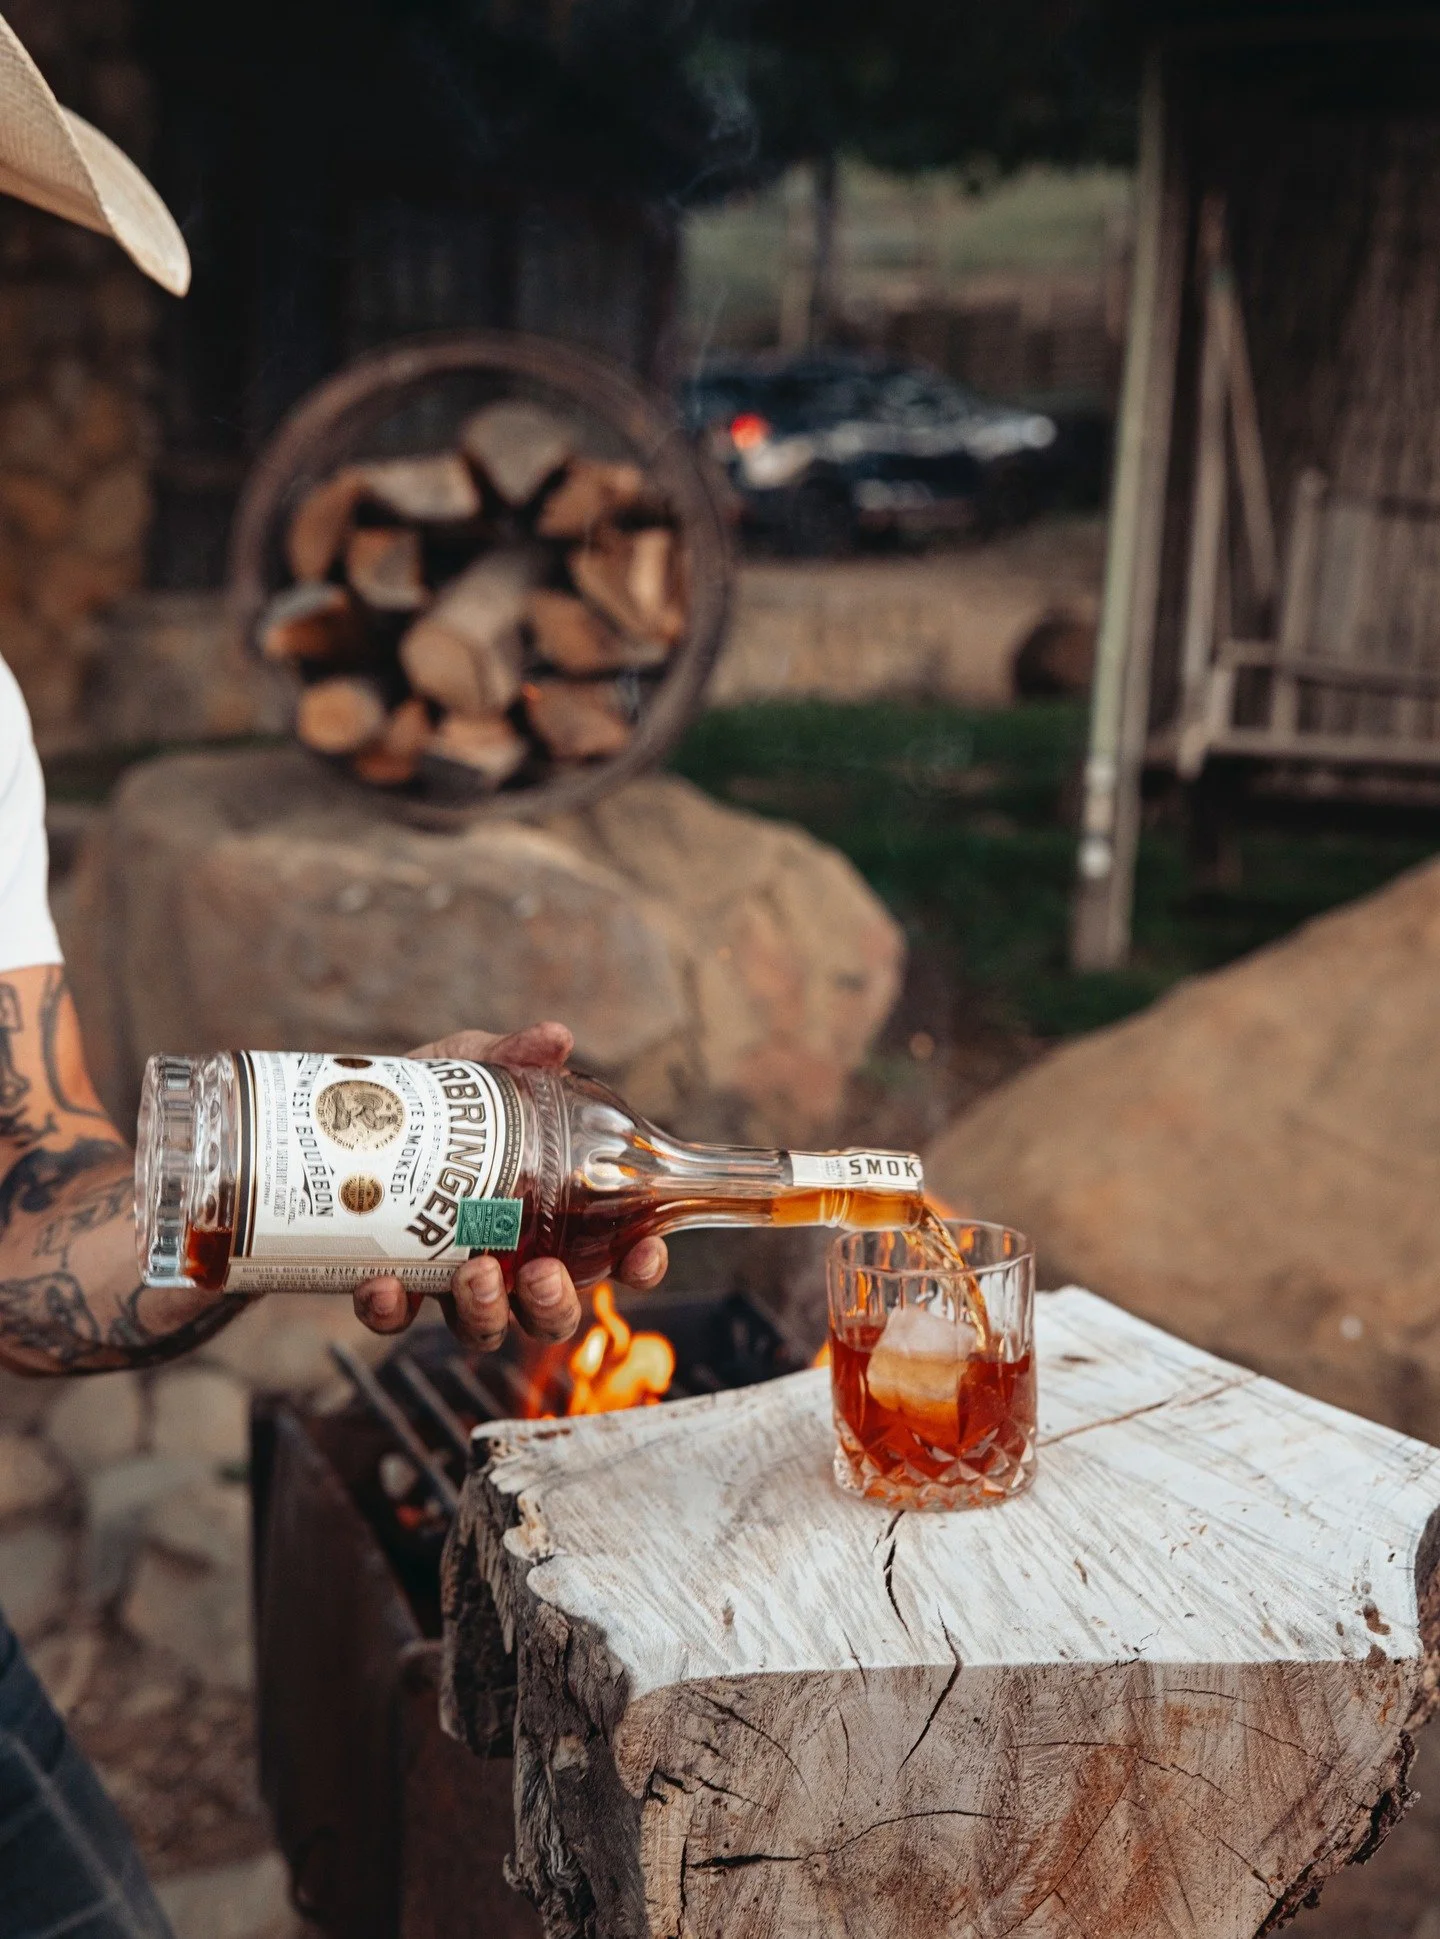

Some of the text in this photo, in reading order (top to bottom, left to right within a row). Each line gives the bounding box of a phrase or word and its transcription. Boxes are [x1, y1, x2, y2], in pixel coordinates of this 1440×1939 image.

[296, 1127, 334, 1218] BOURBON
[390, 1123, 424, 1195] SMOKED
[405, 1060, 487, 1248] ARBRINGER
[849, 1158, 918, 1178] SMOK
